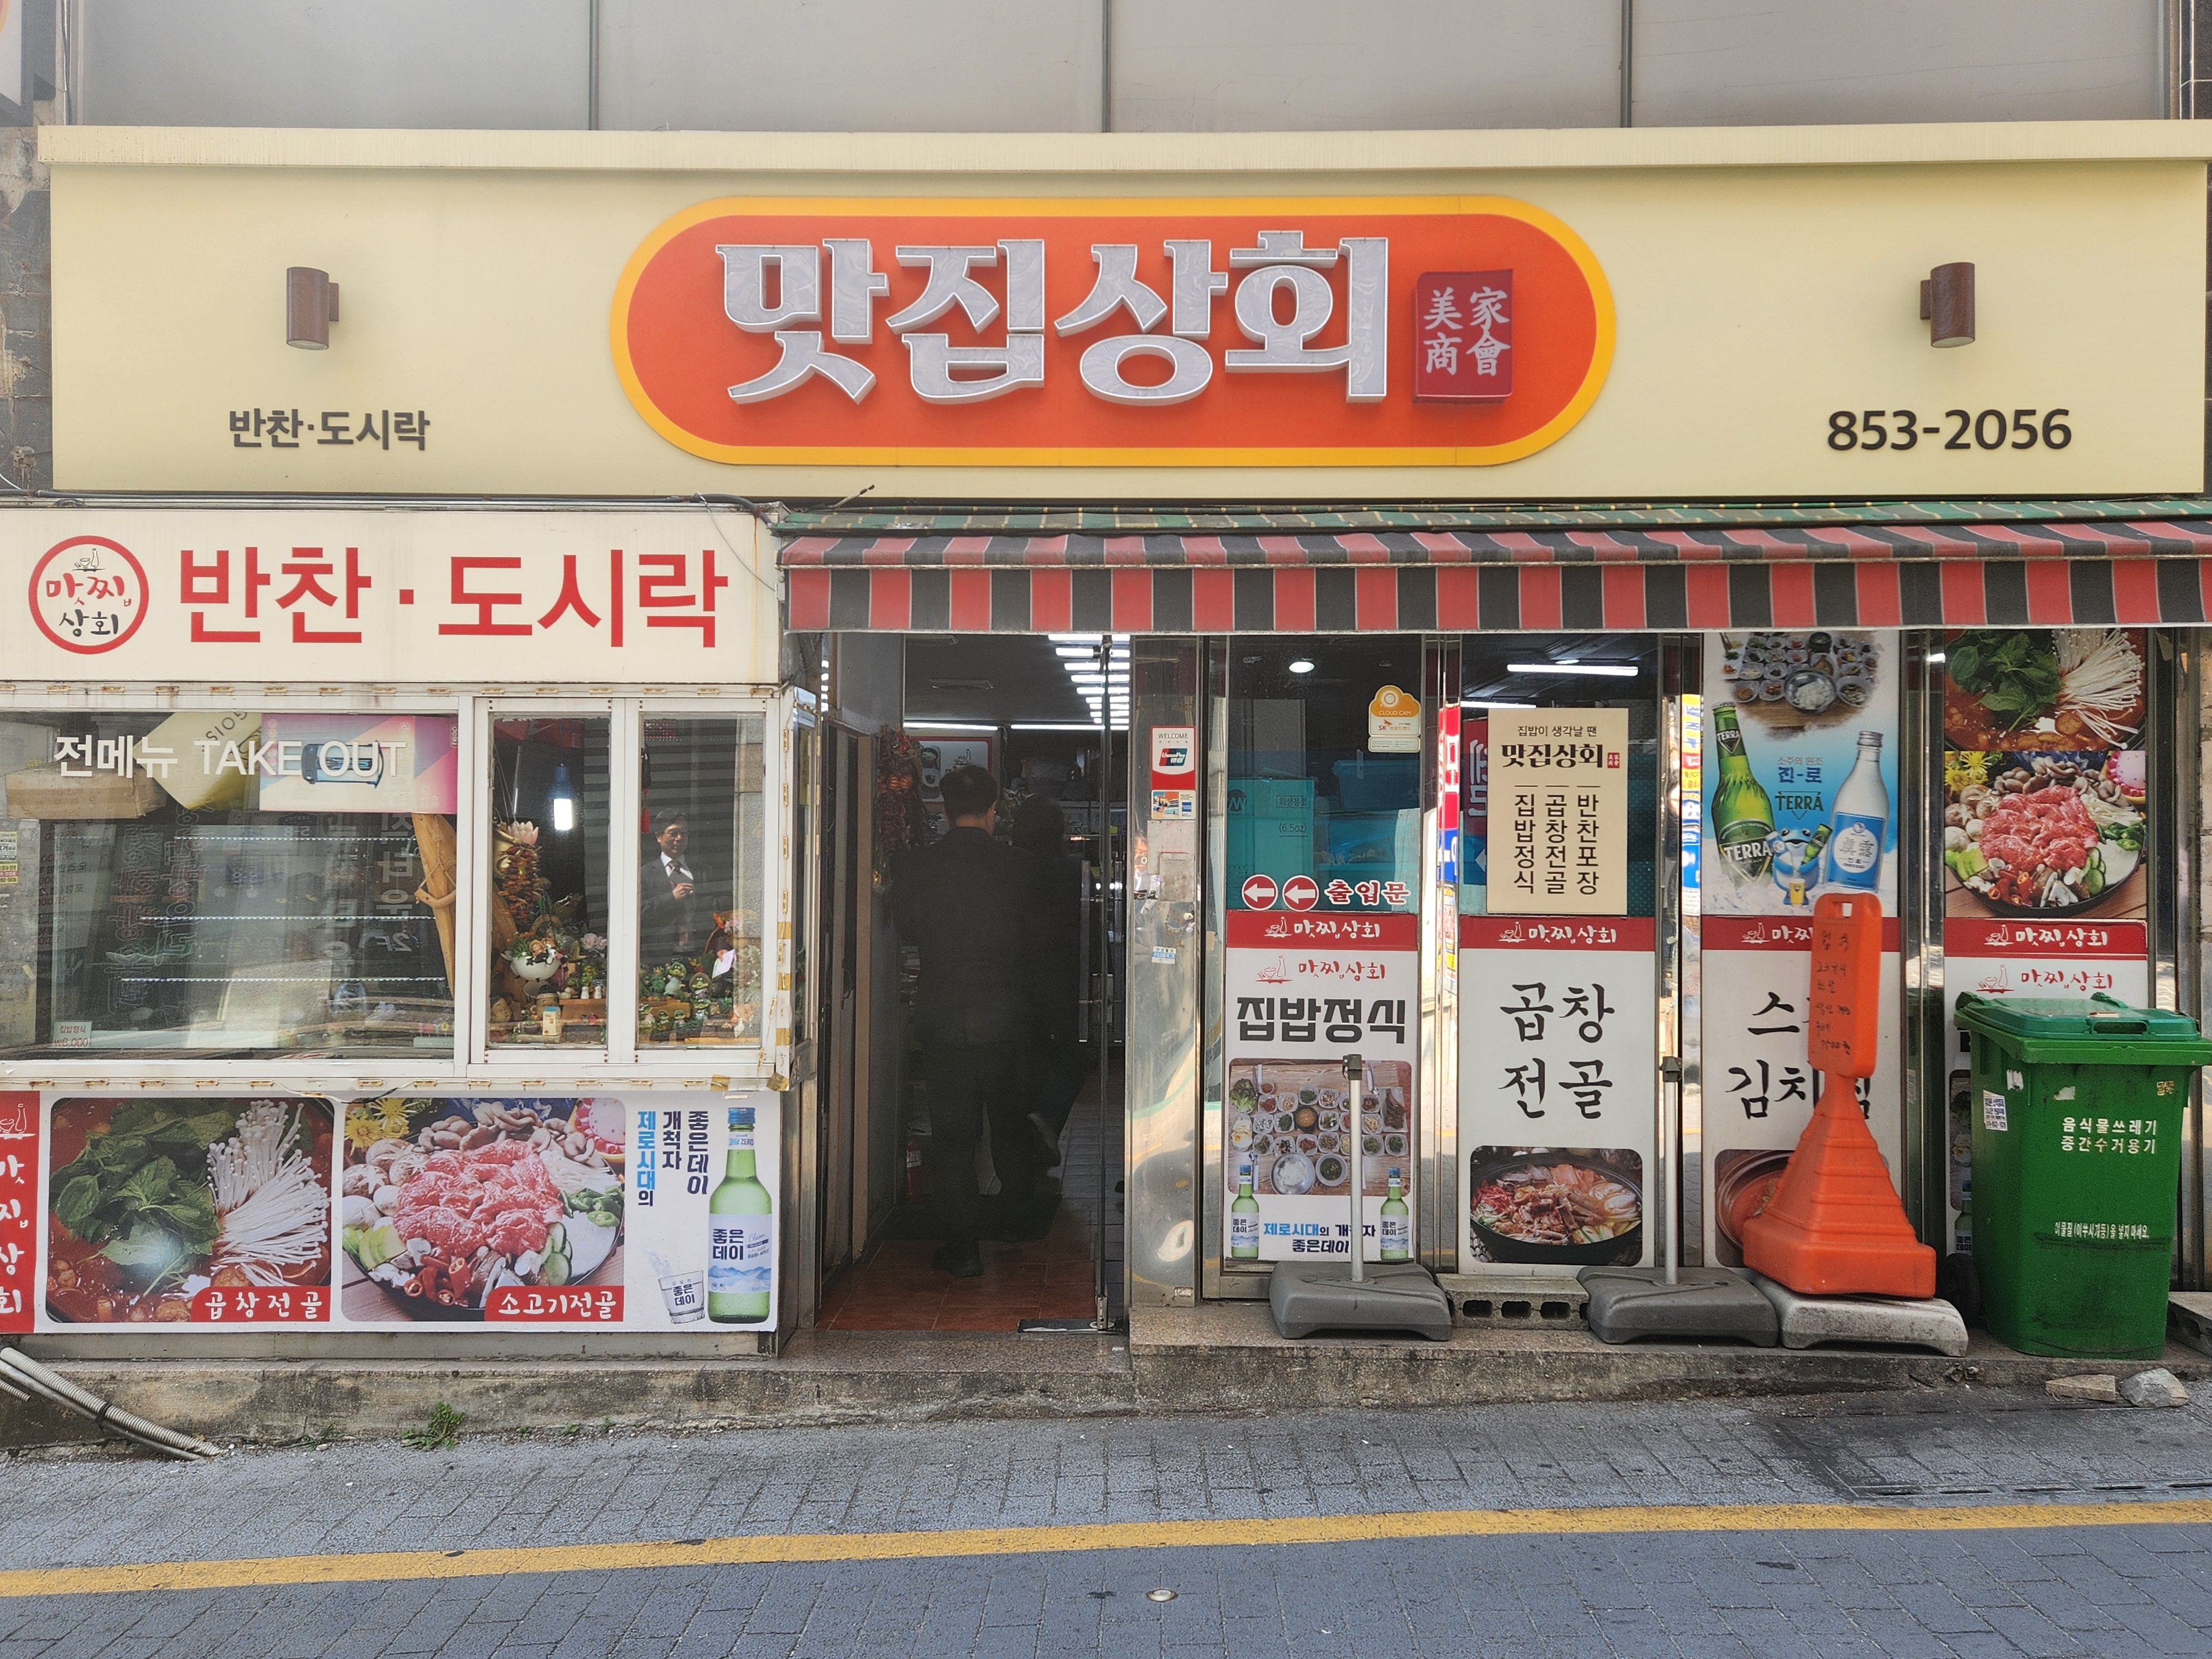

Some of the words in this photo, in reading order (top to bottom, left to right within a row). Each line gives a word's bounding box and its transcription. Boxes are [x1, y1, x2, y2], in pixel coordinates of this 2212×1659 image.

[715, 230, 1389, 406] 맛집상회
[229, 408, 430, 450] 반찬·도시락
[1828, 409, 2072, 451] 853-2056
[59, 609, 118, 637] 상회
[1517, 726, 1548, 737] 집밥이
[1552, 726, 1583, 737] 생각날
[1587, 726, 1597, 737] 땐
[1717, 729, 1741, 742] TERRA
[54, 734, 178, 779] 전메뉴
[194, 740, 302, 775] TAKE
[319, 740, 406, 778] OUT
[1501, 744, 1603, 768] 맛집상회
[1775, 795, 1824, 812] TERRA
[1513, 794, 1536, 894] 집밥정식
[1545, 794, 1568, 895] 곱창전골
[1576, 794, 1600, 895] 반찬포장
[1724, 840, 1773, 862] TERRA
[1324, 879, 1411, 905] 출입문
[1237, 997, 1406, 1044] 집밥정식
[1499, 982, 1615, 1044] 곱창
[1747, 992, 1810, 1035] 스
[60, 1025, 86, 1034] 집밥정식
[1498, 1057, 1613, 1120] 전골
[662, 1110, 682, 1170] 개척자
[2062, 1117, 2157, 1135] 음식물쓰레기
[637, 1110, 656, 1207] 제로시대의
[687, 1110, 709, 1195] 좋은데이
[2060, 1136, 2156, 1154] 중간수거용기
[713, 1228, 744, 1244] 좋은
[1263, 1223, 1329, 1237] 제로시대의
[1334, 1224, 1376, 1238] 개자
[2054, 1220, 2073, 1238] 이물질
[2118, 1224, 2130, 1240] 넣지
[2130, 1224, 2150, 1240] 마세요.
[713, 1245, 743, 1260] 데이
[1292, 1239, 1350, 1253] 좋은데이
[673, 1284, 693, 1296] 좋은
[675, 1294, 695, 1306] 데이
[205, 1291, 322, 1320] 곱창전골
[498, 1291, 617, 1320] 소고기전골
